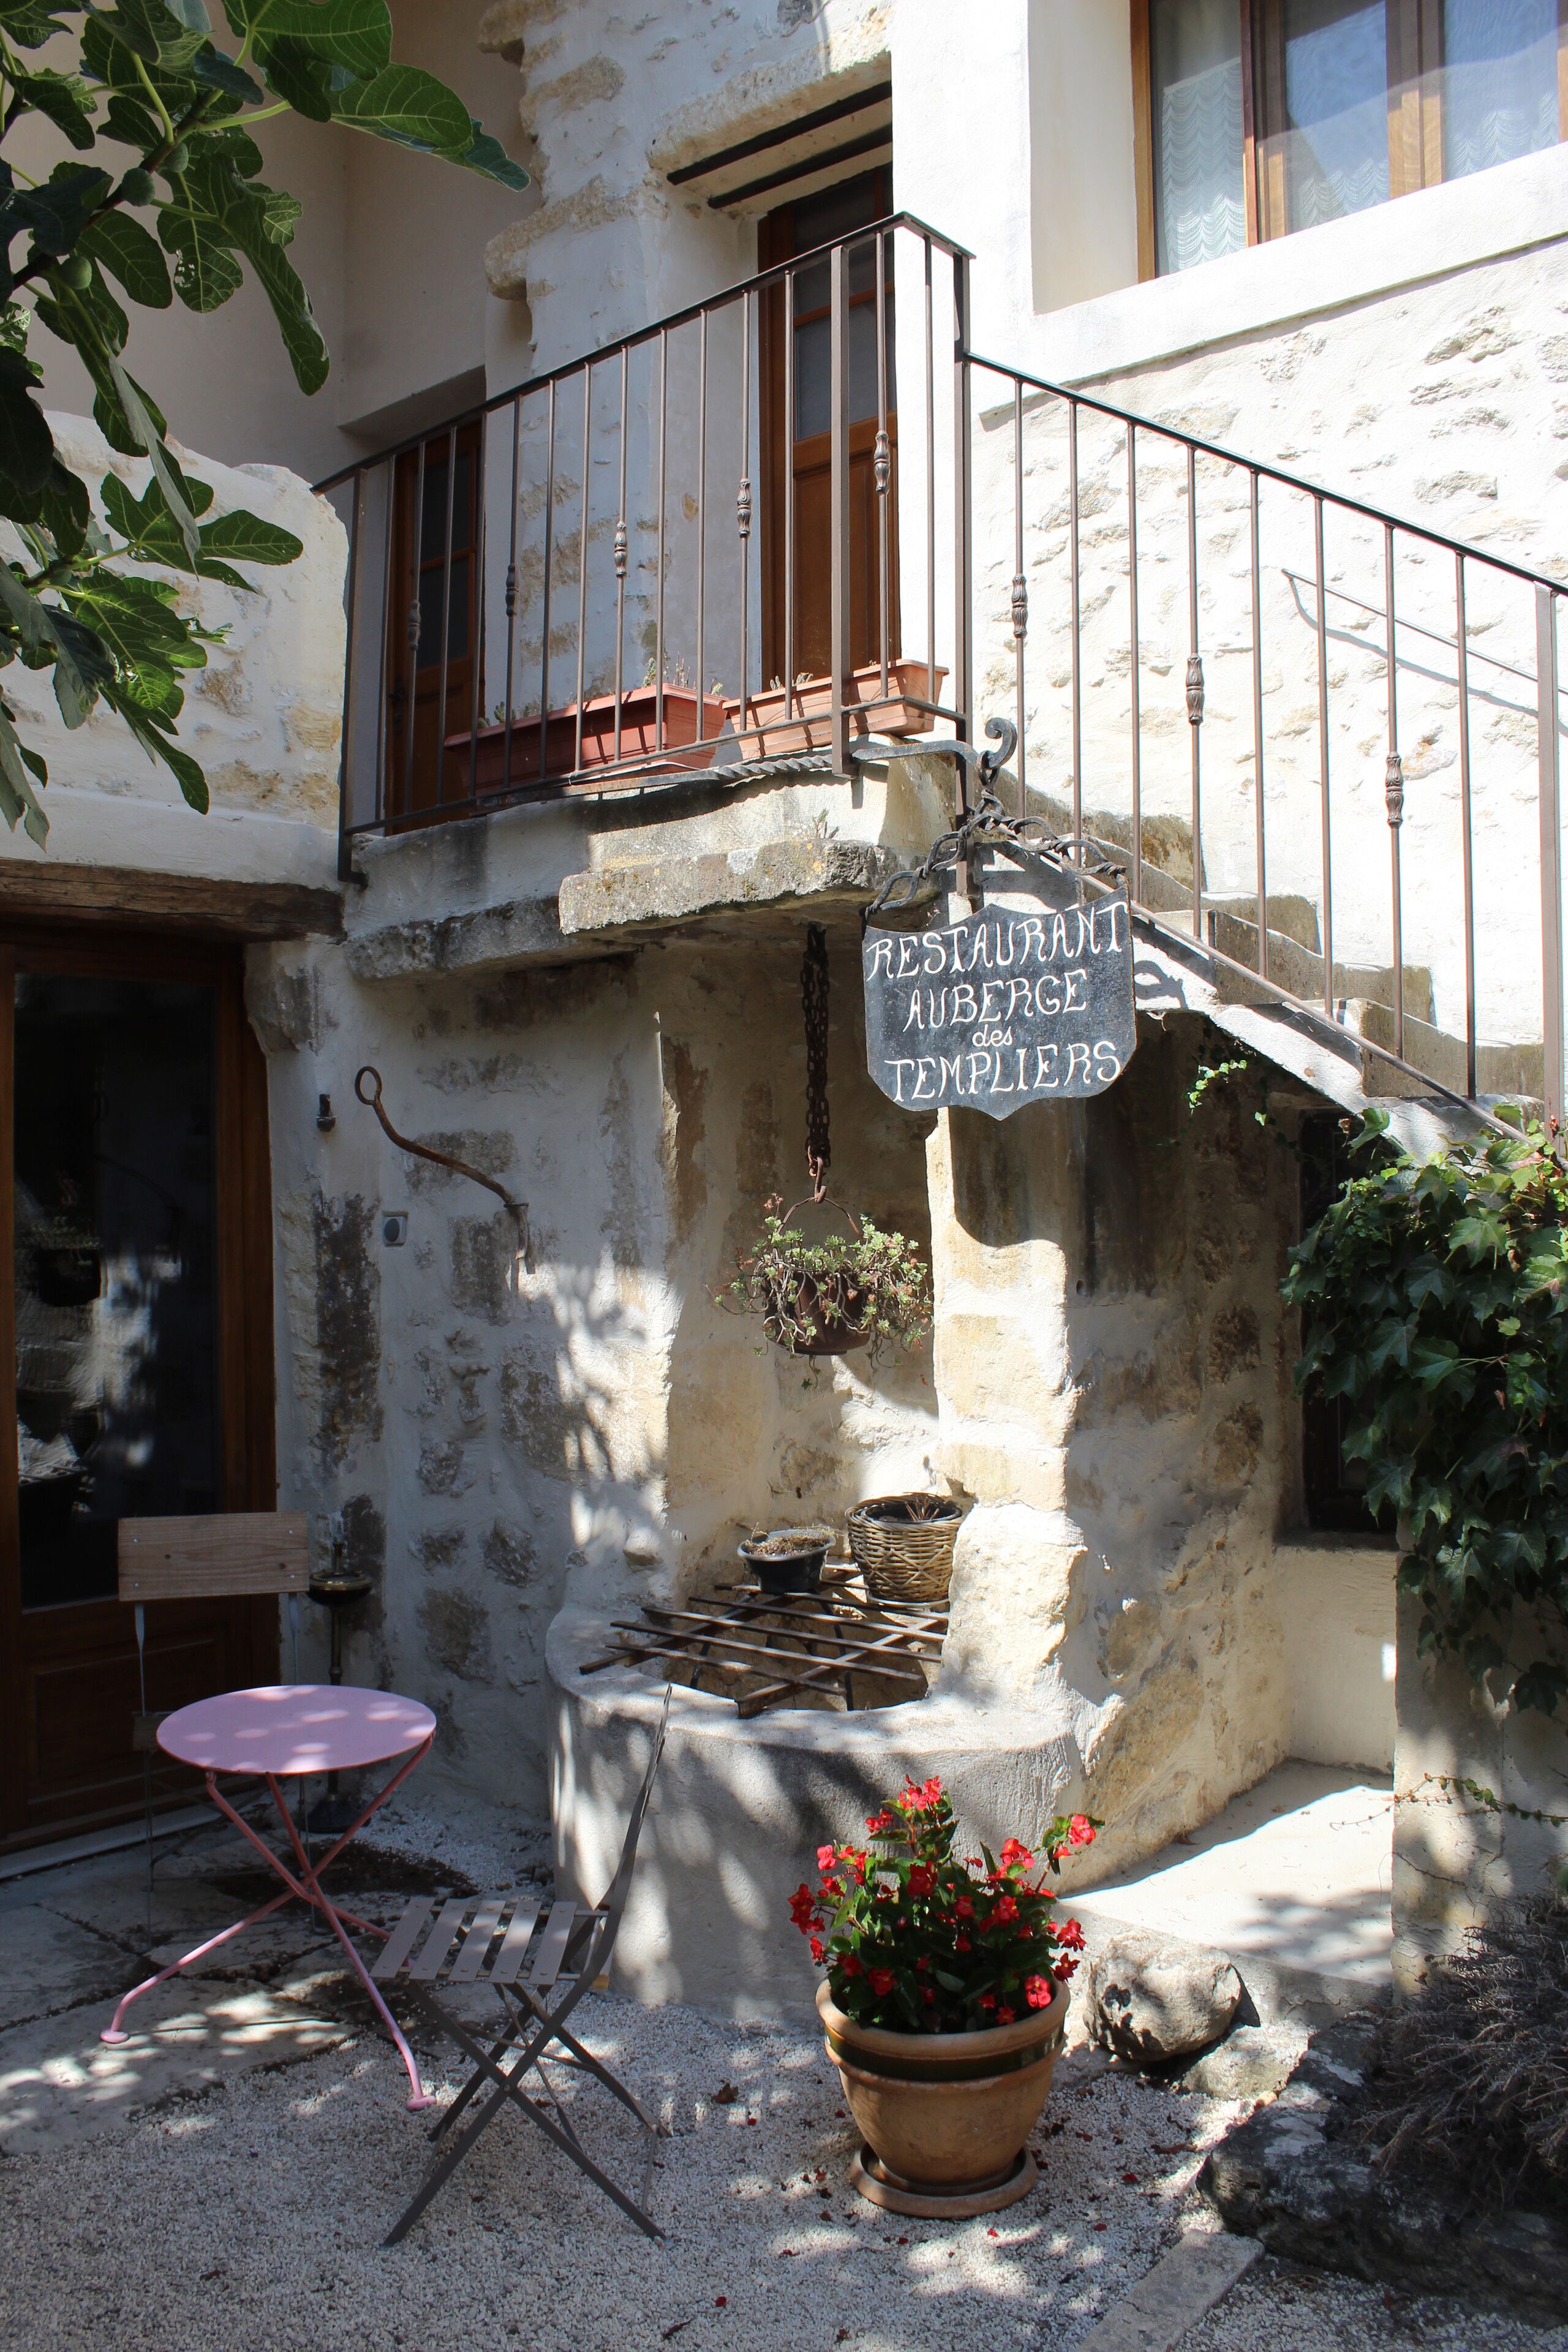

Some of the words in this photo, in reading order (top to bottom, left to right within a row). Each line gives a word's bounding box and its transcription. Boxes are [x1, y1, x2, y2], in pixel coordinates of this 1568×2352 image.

[865, 901, 1129, 982] RESTAURANT
[903, 969, 1087, 1032] AUBERGE
[971, 1024, 1012, 1047] des
[884, 1041, 1121, 1102] TEMPLIERS
